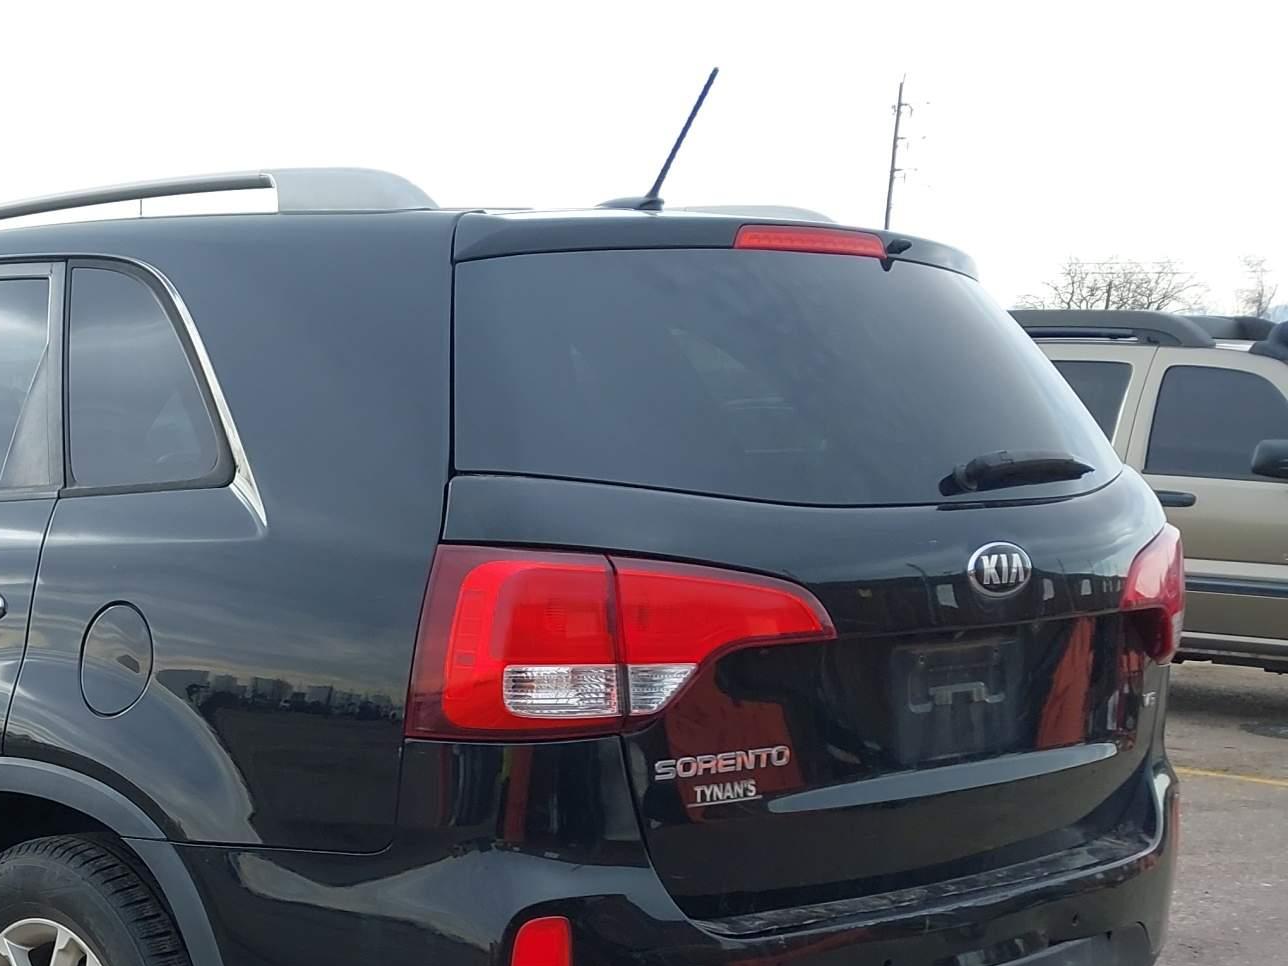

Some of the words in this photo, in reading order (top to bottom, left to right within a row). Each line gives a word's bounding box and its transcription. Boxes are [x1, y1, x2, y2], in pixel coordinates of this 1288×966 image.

[980, 553, 1025, 585] KIA
[654, 745, 791, 781] SORENTO
[694, 779, 757, 803] TYNAN'S
